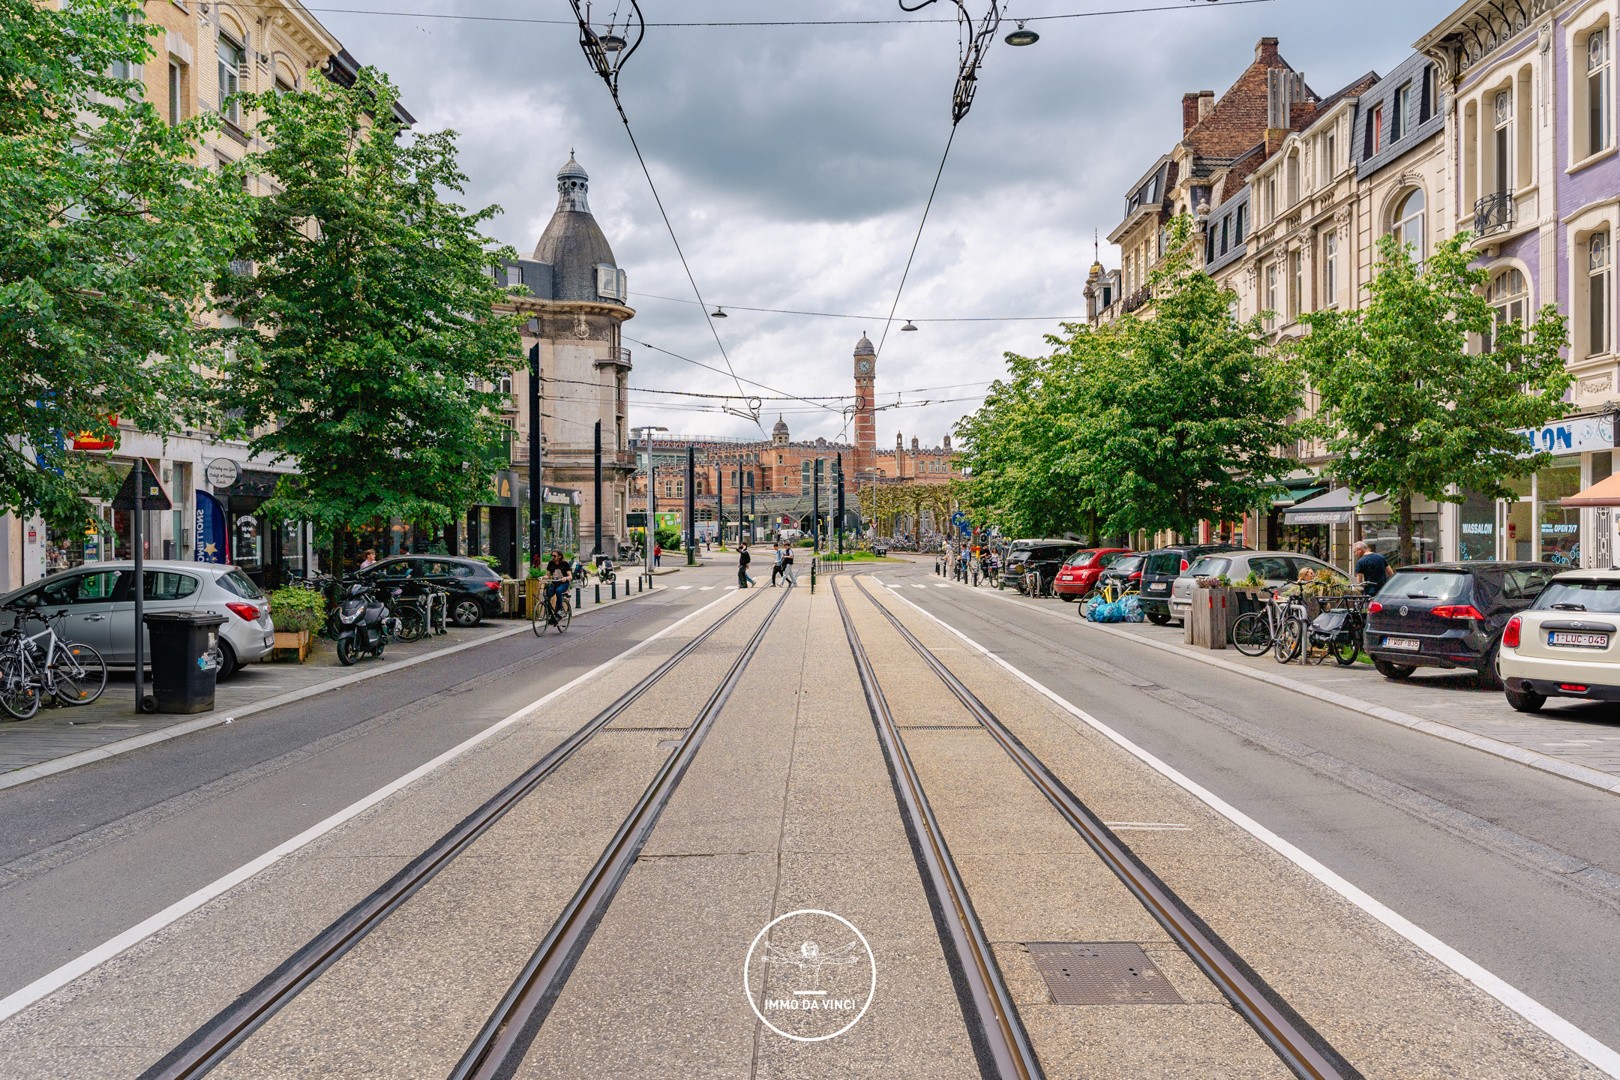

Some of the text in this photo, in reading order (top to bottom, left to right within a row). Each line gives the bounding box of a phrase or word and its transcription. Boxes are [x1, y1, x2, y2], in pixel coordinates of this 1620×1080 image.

[1519, 425, 1572, 452] LON
[1462, 523, 1493, 535] WASSALON
[1554, 524, 1568, 533] OPEN
[1555, 634, 1606, 645] 1-LUC-045
